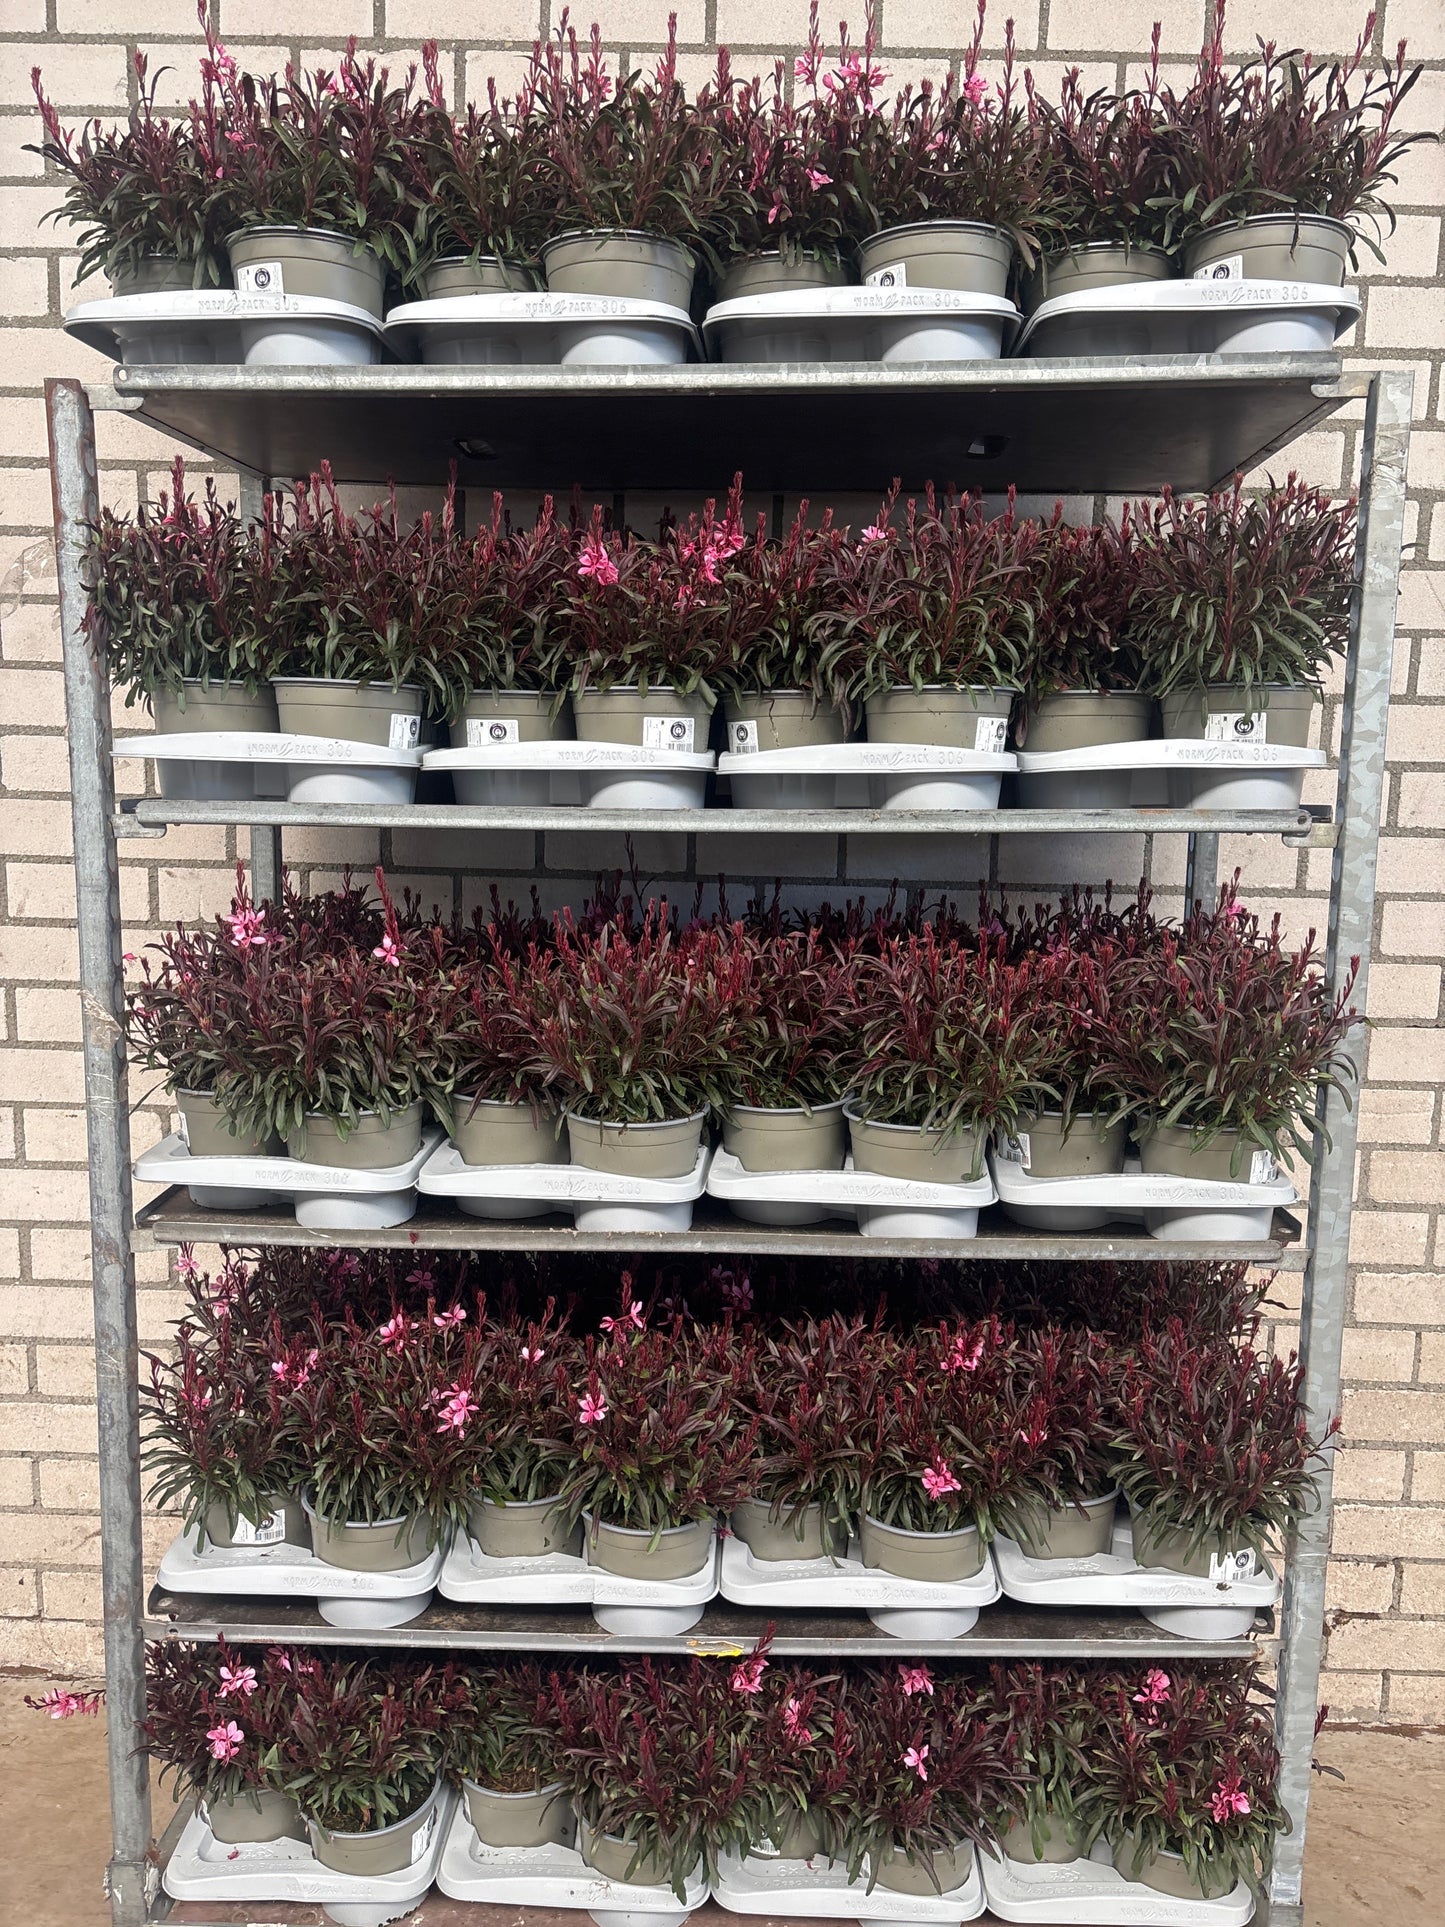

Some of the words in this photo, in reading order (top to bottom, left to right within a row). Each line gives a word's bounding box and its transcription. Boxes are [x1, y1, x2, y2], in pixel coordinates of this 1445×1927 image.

[935, 293, 960, 307] 306
[1282, 286, 1308, 301] 306
[602, 299, 626, 314] 306
[631, 750, 656, 763] 306
[938, 751, 963, 765] 306
